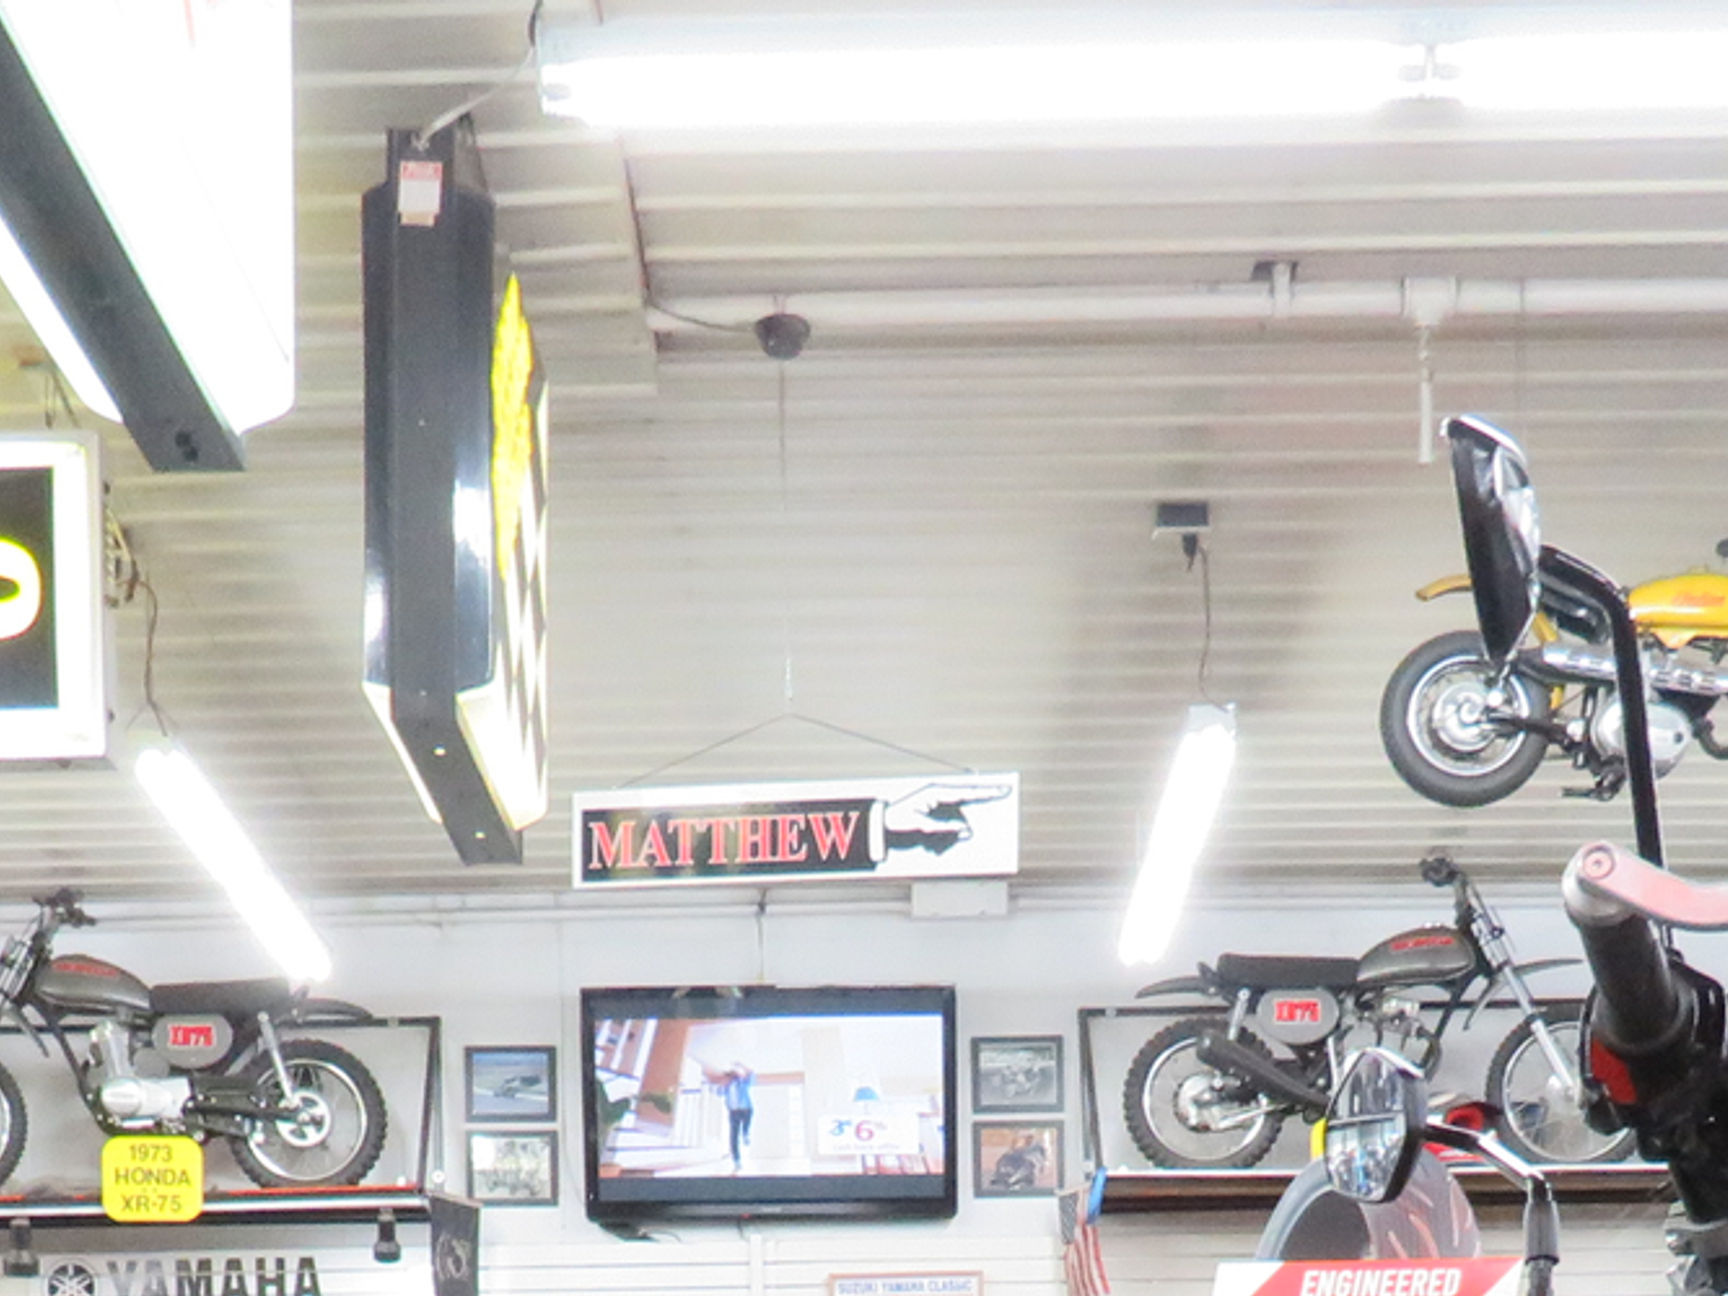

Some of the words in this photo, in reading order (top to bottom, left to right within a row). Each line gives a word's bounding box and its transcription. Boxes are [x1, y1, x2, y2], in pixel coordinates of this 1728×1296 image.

[588, 811, 861, 870] MATTHEW
[129, 1143, 174, 1162] 1973
[113, 1166, 192, 1186] HONDA
[120, 1193, 183, 1213] XR-75
